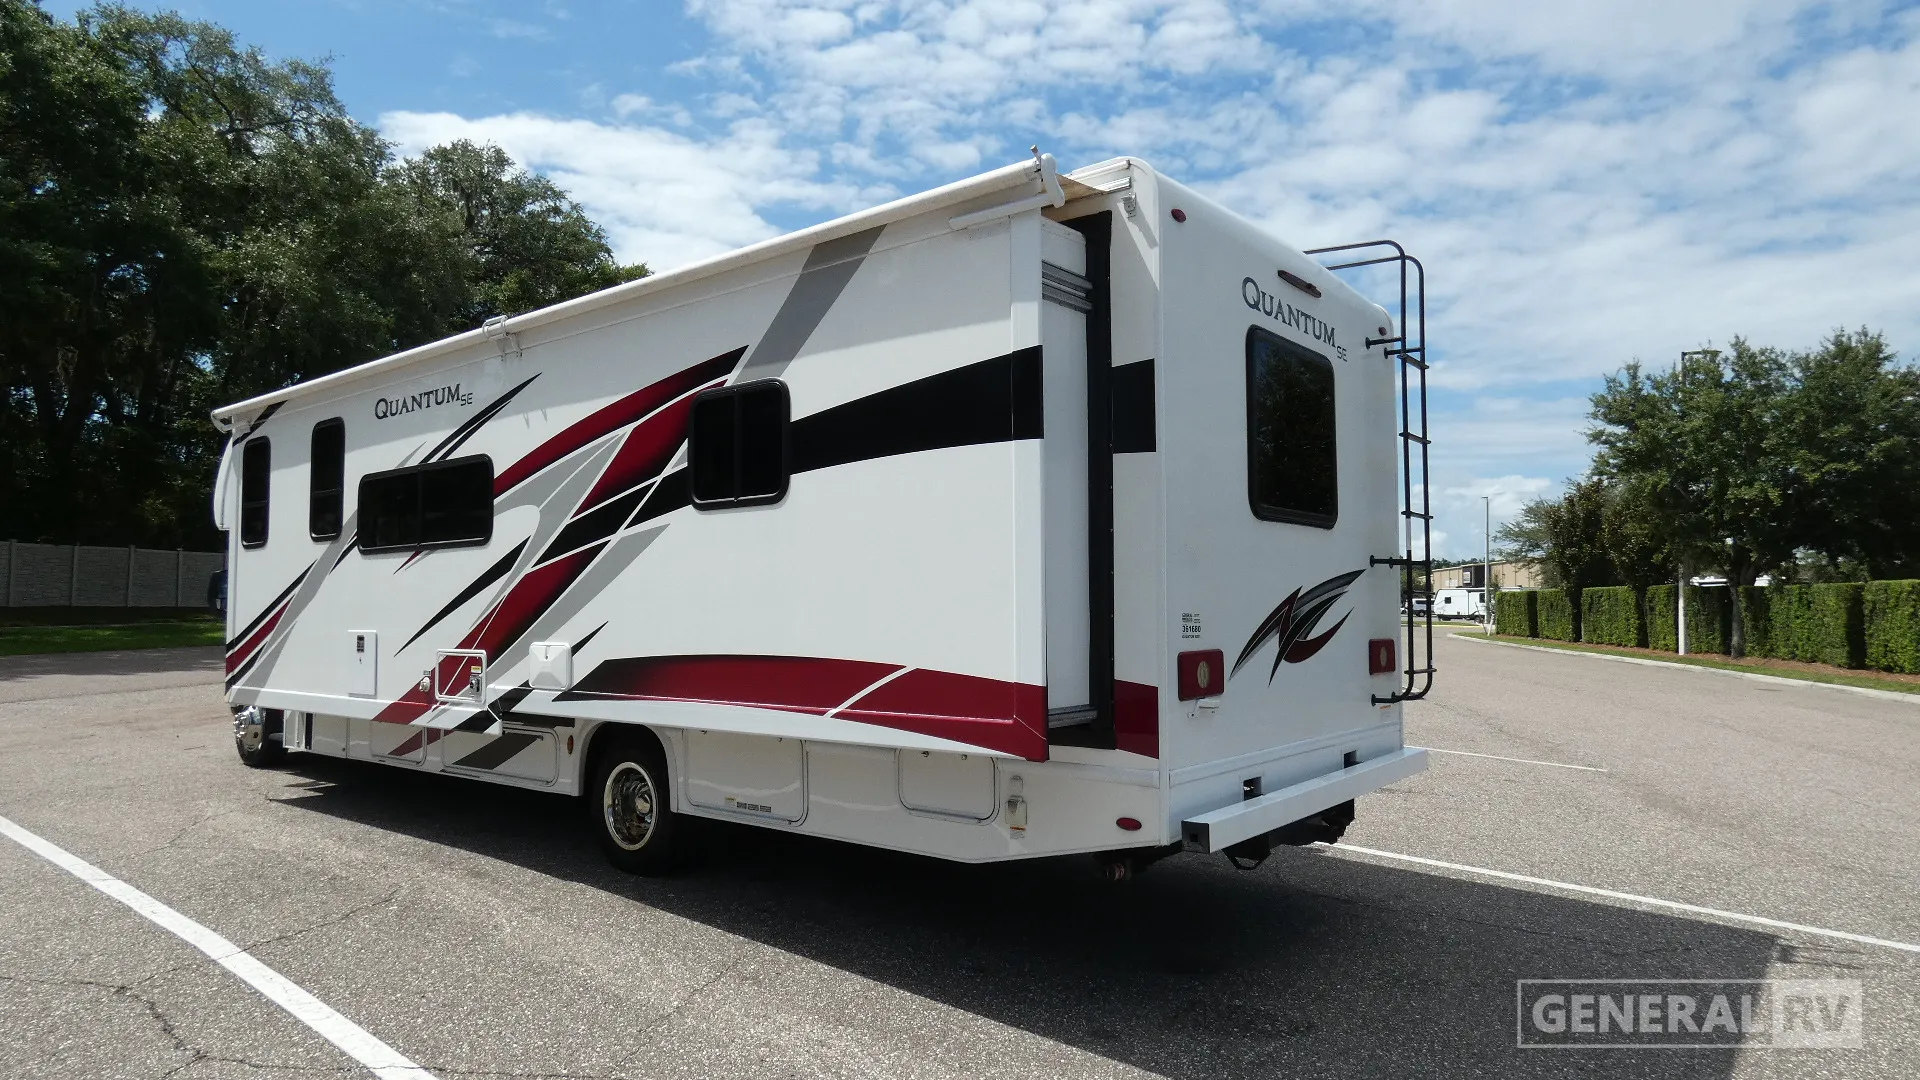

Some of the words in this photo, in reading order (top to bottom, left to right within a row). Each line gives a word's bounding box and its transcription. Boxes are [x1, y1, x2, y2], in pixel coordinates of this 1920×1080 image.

[1242, 276, 1336, 348] QUANTUM
[1336, 345, 1347, 362] SE
[374, 383, 460, 420] QUANTUM
[460, 392, 473, 406] SE
